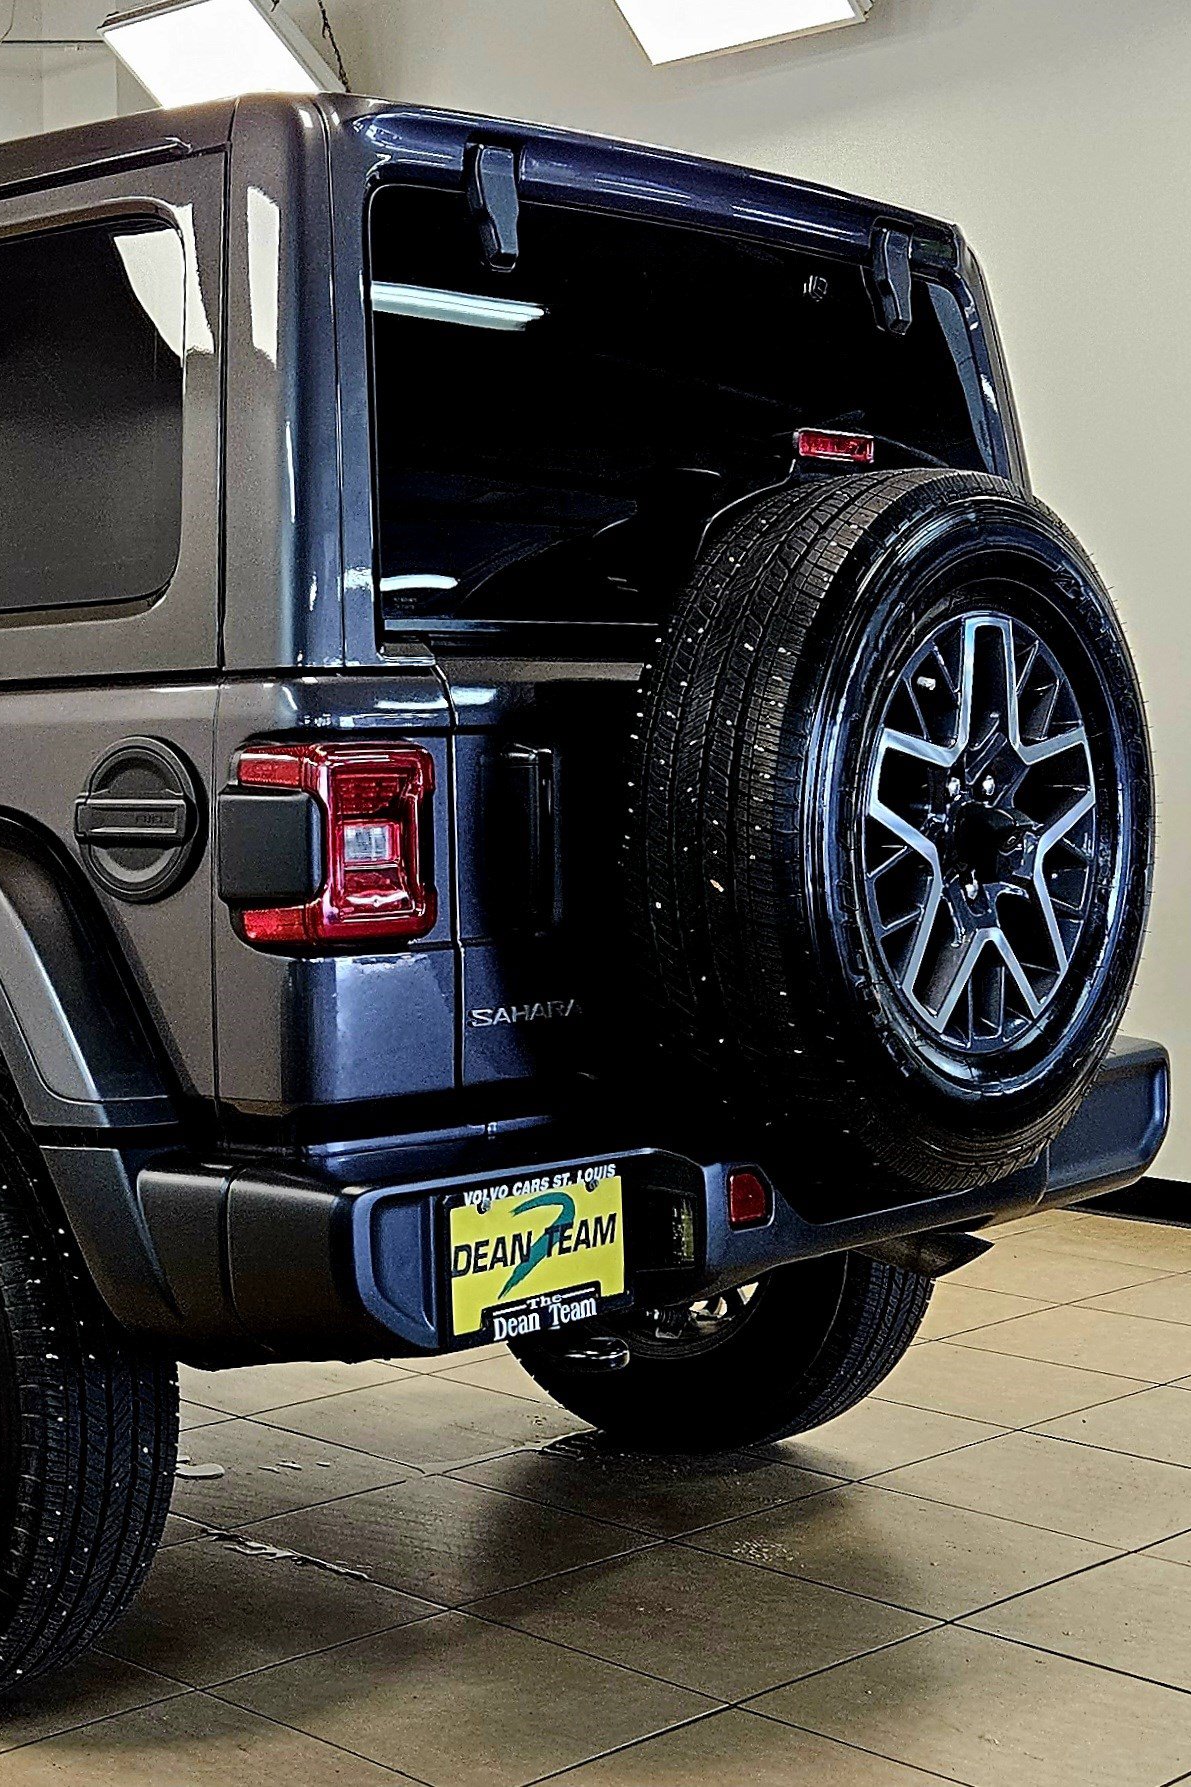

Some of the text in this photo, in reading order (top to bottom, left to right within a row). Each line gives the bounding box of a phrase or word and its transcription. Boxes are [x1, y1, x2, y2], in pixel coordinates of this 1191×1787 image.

[470, 998, 583, 1027] SAHARA
[463, 1163, 616, 1206] VOLVO CARS ST. LOUIS
[452, 1213, 617, 1278] DEAN TEAM
[493, 1297, 597, 1341] Dean Team
[526, 1294, 562, 1310] The
